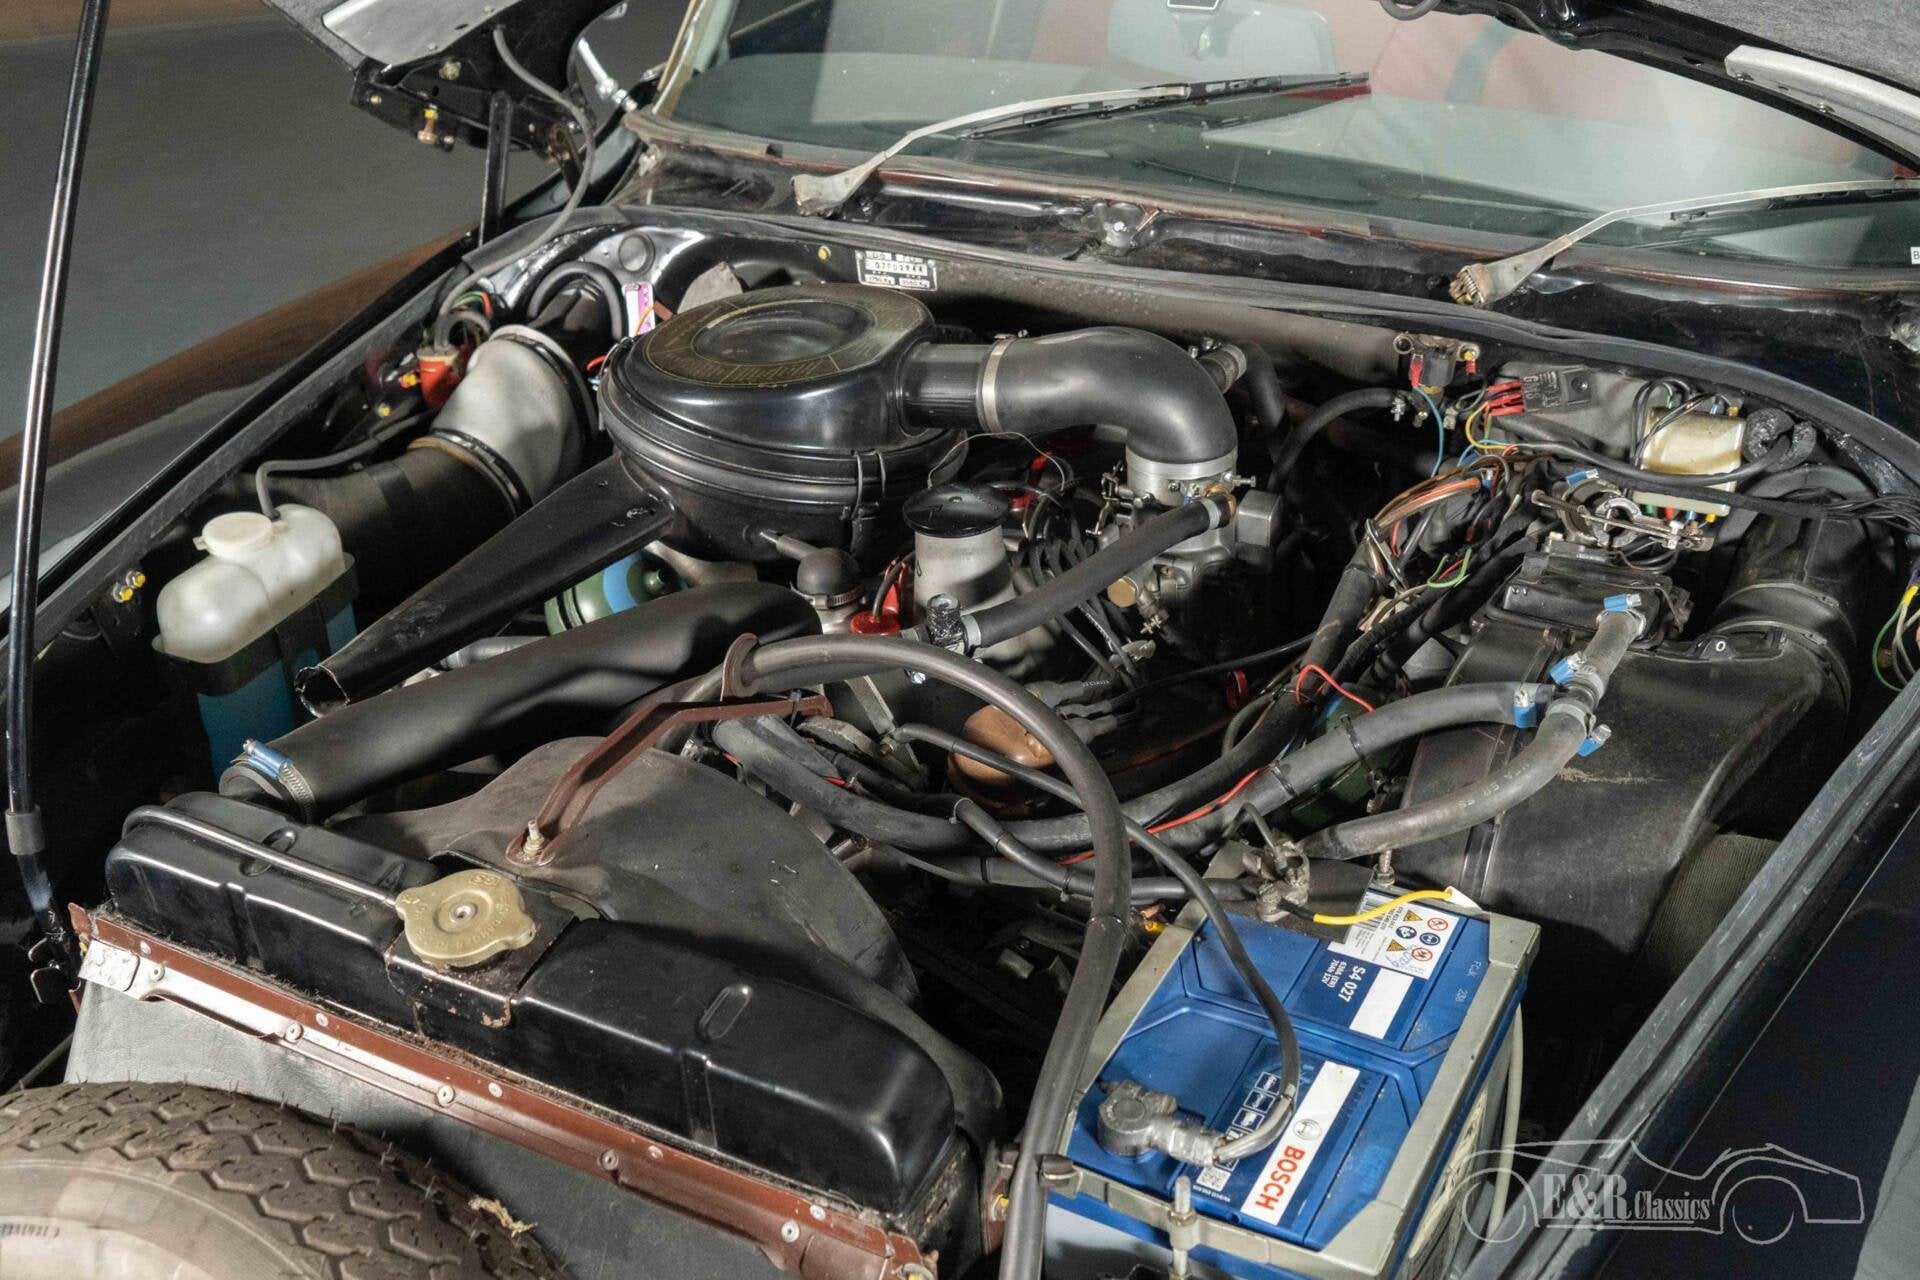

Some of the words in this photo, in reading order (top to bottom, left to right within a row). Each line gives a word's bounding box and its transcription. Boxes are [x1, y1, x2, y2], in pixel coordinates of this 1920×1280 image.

[1348, 965, 1366, 982] S4
[1338, 981, 1359, 1003] 027
[1255, 1145, 1307, 1212] BOSCH
